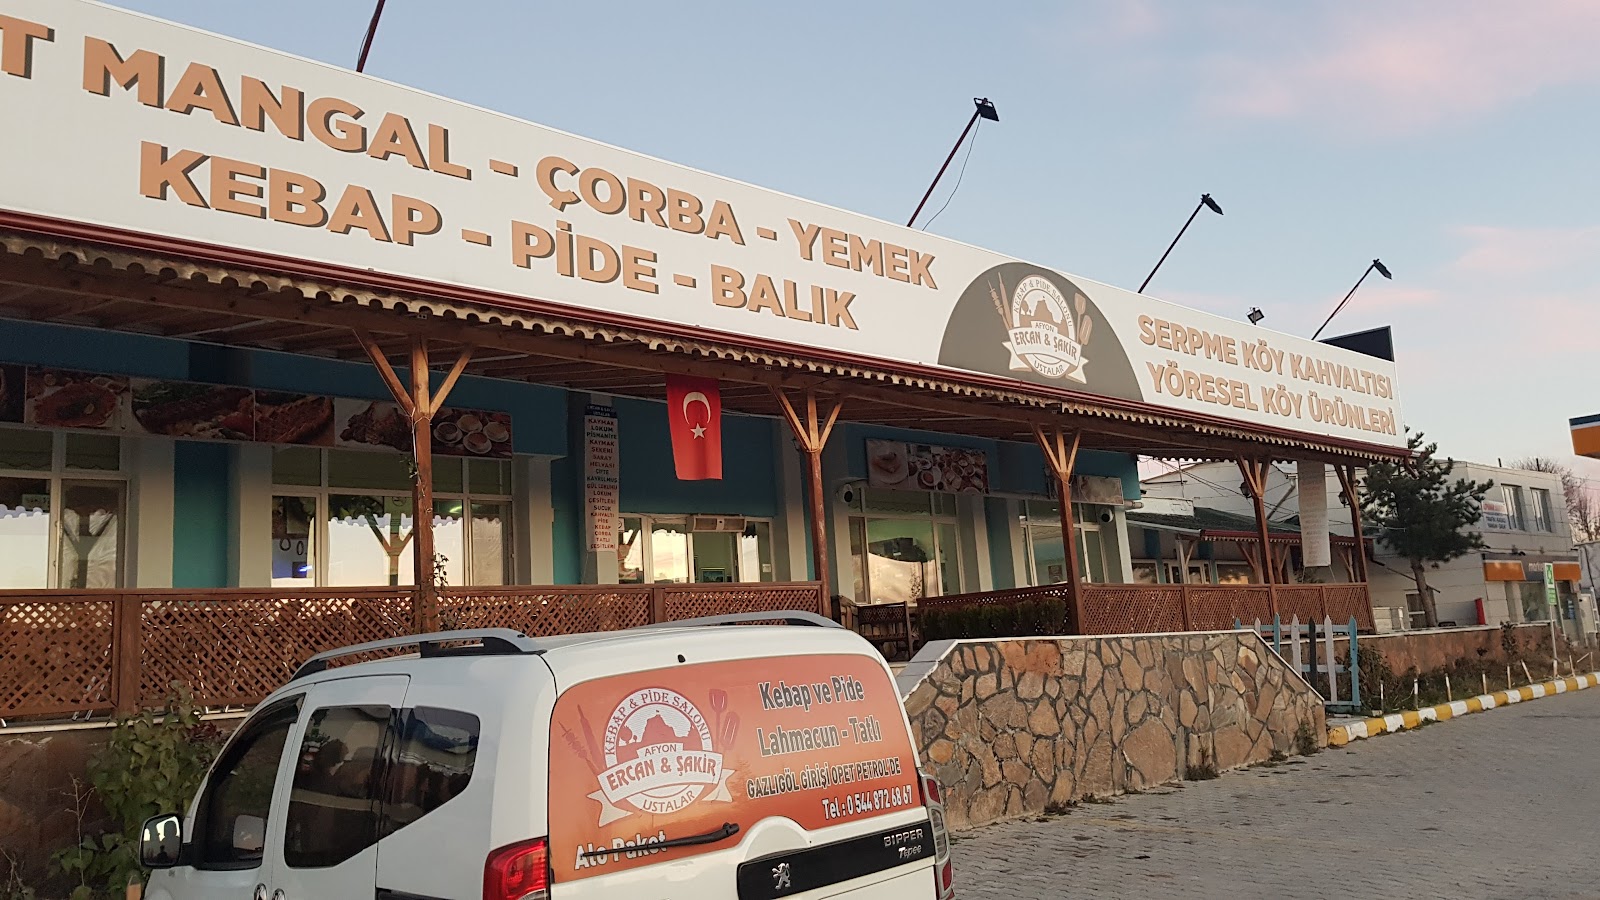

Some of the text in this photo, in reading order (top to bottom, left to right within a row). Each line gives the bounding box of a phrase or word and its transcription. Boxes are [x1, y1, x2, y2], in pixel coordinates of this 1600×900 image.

[83, 36, 471, 180] MANGAL
[536, 156, 746, 246] ÇORBA
[787, 218, 939, 290] YEMEK
[140, 141, 442, 246] KEBAP
[511, 219, 659, 294] PİDE
[711, 263, 858, 330] BALIK
[1014, 282, 1027, 314] KEBAP
[1035, 322, 1055, 333] AFYON
[1014, 331, 1077, 361] ERCAN & ŞAKİR
[1138, 314, 1393, 400] SERPME KÖY KAHVALTISI
[1034, 360, 1064, 376] USTALAR
[1146, 359, 1396, 436] YÖRESEL KÖY ÜRÜNLERİ
[588, 418, 614, 426] KAYMAK
[591, 425, 613, 433] LOKUM
[590, 439, 615, 447] KAYMAK
[758, 675, 864, 712] Kebap ve Pide
[605, 690, 711, 755] KEBAP & PİDE SALONU
[757, 725, 840, 758] Lahmacun
[848, 715, 882, 744] Tatlı
[644, 744, 677, 757] AFYON
[606, 754, 717, 791] ERCAN & ŞAKİR
[747, 757, 901, 800] GAZLIGÖL GİRİŞİ OPET PETROL'DE
[642, 790, 695, 812] USTALAR
[847, 796, 854, 815] 0
[855, 792, 873, 813] 544
[873, 789, 891, 810] 872
[891, 786, 903, 807] 68
[903, 784, 913, 805] 67
[884, 829, 924, 847] BIPPER
[899, 845, 922, 859] Tepee
[574, 843, 608, 870] Alo
